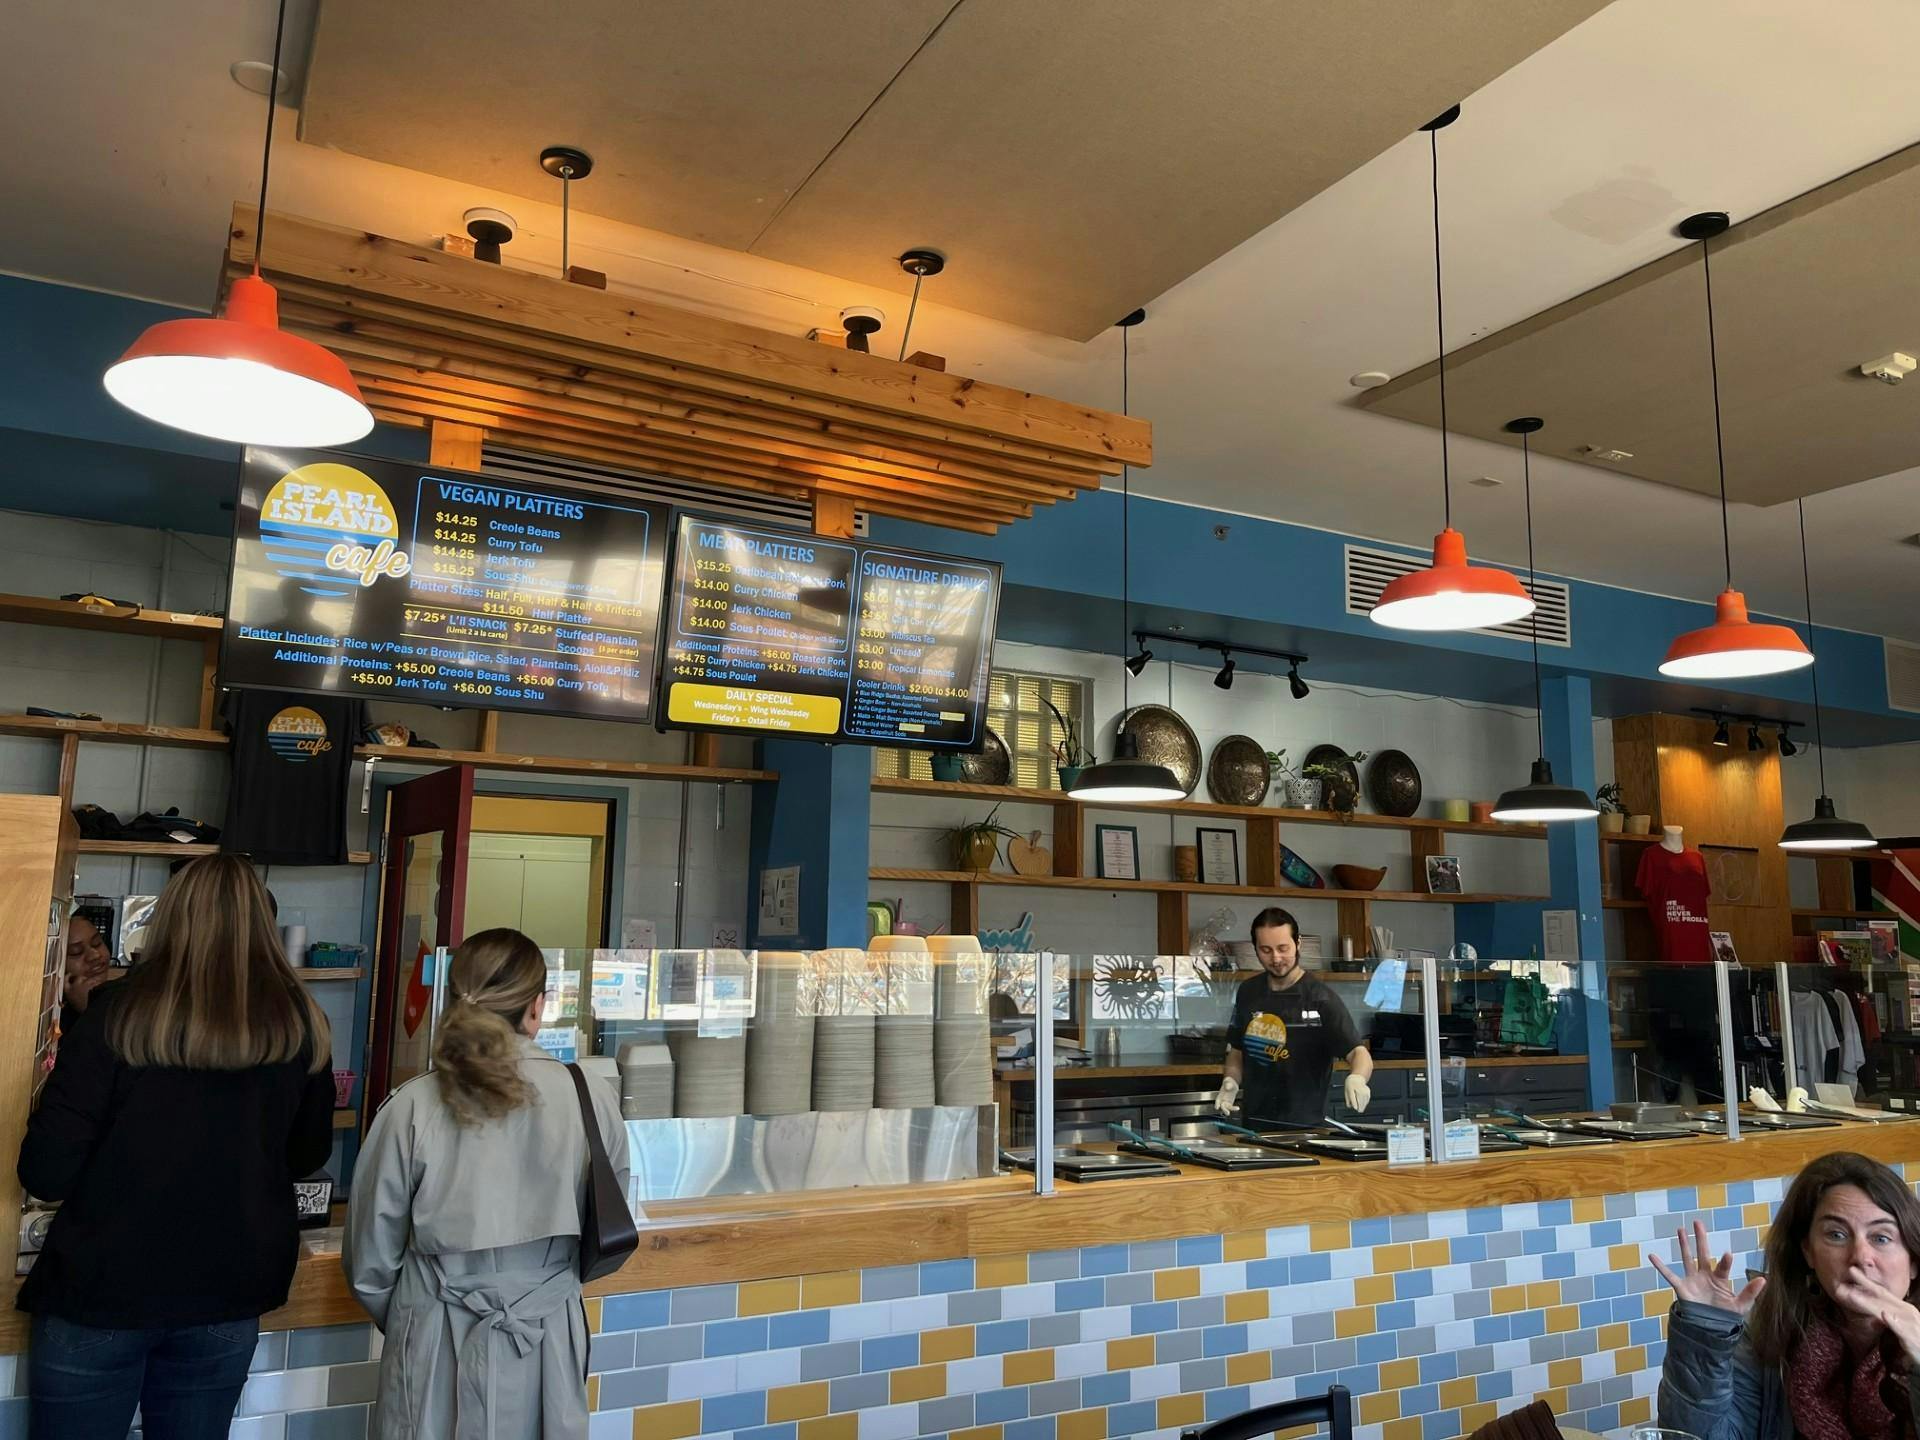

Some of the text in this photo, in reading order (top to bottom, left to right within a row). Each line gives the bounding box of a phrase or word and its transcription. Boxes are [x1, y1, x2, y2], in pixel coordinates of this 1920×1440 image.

[283, 482, 383, 513] PEARL
[440, 484, 584, 520] VEGAN PLATTERS
[270, 498, 392, 533] ISLAND
[436, 511, 561, 540] $14.25 Creole Beans
[434, 528, 543, 553] $14.25 Curry Tofu
[746, 538, 815, 562] PLATTERS
[326, 540, 412, 586] cafe
[433, 544, 536, 568] $14.25 Jerk Tofu
[432, 562, 512, 580] $15.25 Sous
[696, 559, 732, 573] $15.25
[826, 578, 846, 590] Pork
[864, 562, 938, 584] SIGNATURE
[410, 580, 642, 617] Platter Sizes: Half, Full, Half & Half & Trifecta
[694, 578, 798, 601] $14.00 Curry Chicken
[483, 602, 592, 624] $11.50 Half Platter
[692, 598, 791, 620] $14.00 Jerk Chicken
[468, 617, 508, 630] SNACK
[555, 628, 593, 641] Stuffed
[596, 632, 638, 646] Plantain
[488, 631, 508, 640] carte)
[690, 616, 726, 630] $14.00
[730, 622, 753, 634] Sous
[860, 628, 886, 638] $3.00
[892, 632, 922, 642] Hibiscus
[240, 626, 282, 640] Platter
[286, 631, 340, 646] Includes:
[343, 638, 368, 649] Rice
[371, 642, 414, 654] w/Peas
[417, 647, 428, 655] or
[430, 646, 464, 659] Brown
[467, 652, 493, 664] Rice,
[556, 643, 594, 656] Scoops
[676, 640, 846, 667] Additional Proteins: +$6.00 Roasted Pork
[859, 644, 884, 654] $3.00
[274, 650, 608, 692] Additional Proteins: +$5.00 Creole Beans +$5.00 Curry Tofu
[672, 666, 756, 682] +$4.75 Sous Poulet
[674, 653, 848, 679] +$4.75 Curry Chicken +$4.75 Jerk Chicken
[858, 660, 883, 670] $3.00
[888, 664, 916, 674] Tropical
[351, 673, 544, 700] +$5.00 Jerk Tofu +$6.00 Sous Shu
[726, 690, 794, 705] DAILY SPECIAL
[856, 680, 968, 698] Cooler Drinks $2.00 to $4.00
[694, 700, 810, 718] Wednesday's Wing Wednesday
[272, 724, 324, 736] ISLAND
[712, 713, 791, 728] Friday's Oxtail Friday
[296, 736, 332, 756] cafe
[1264, 1044, 1290, 1062] cafe
